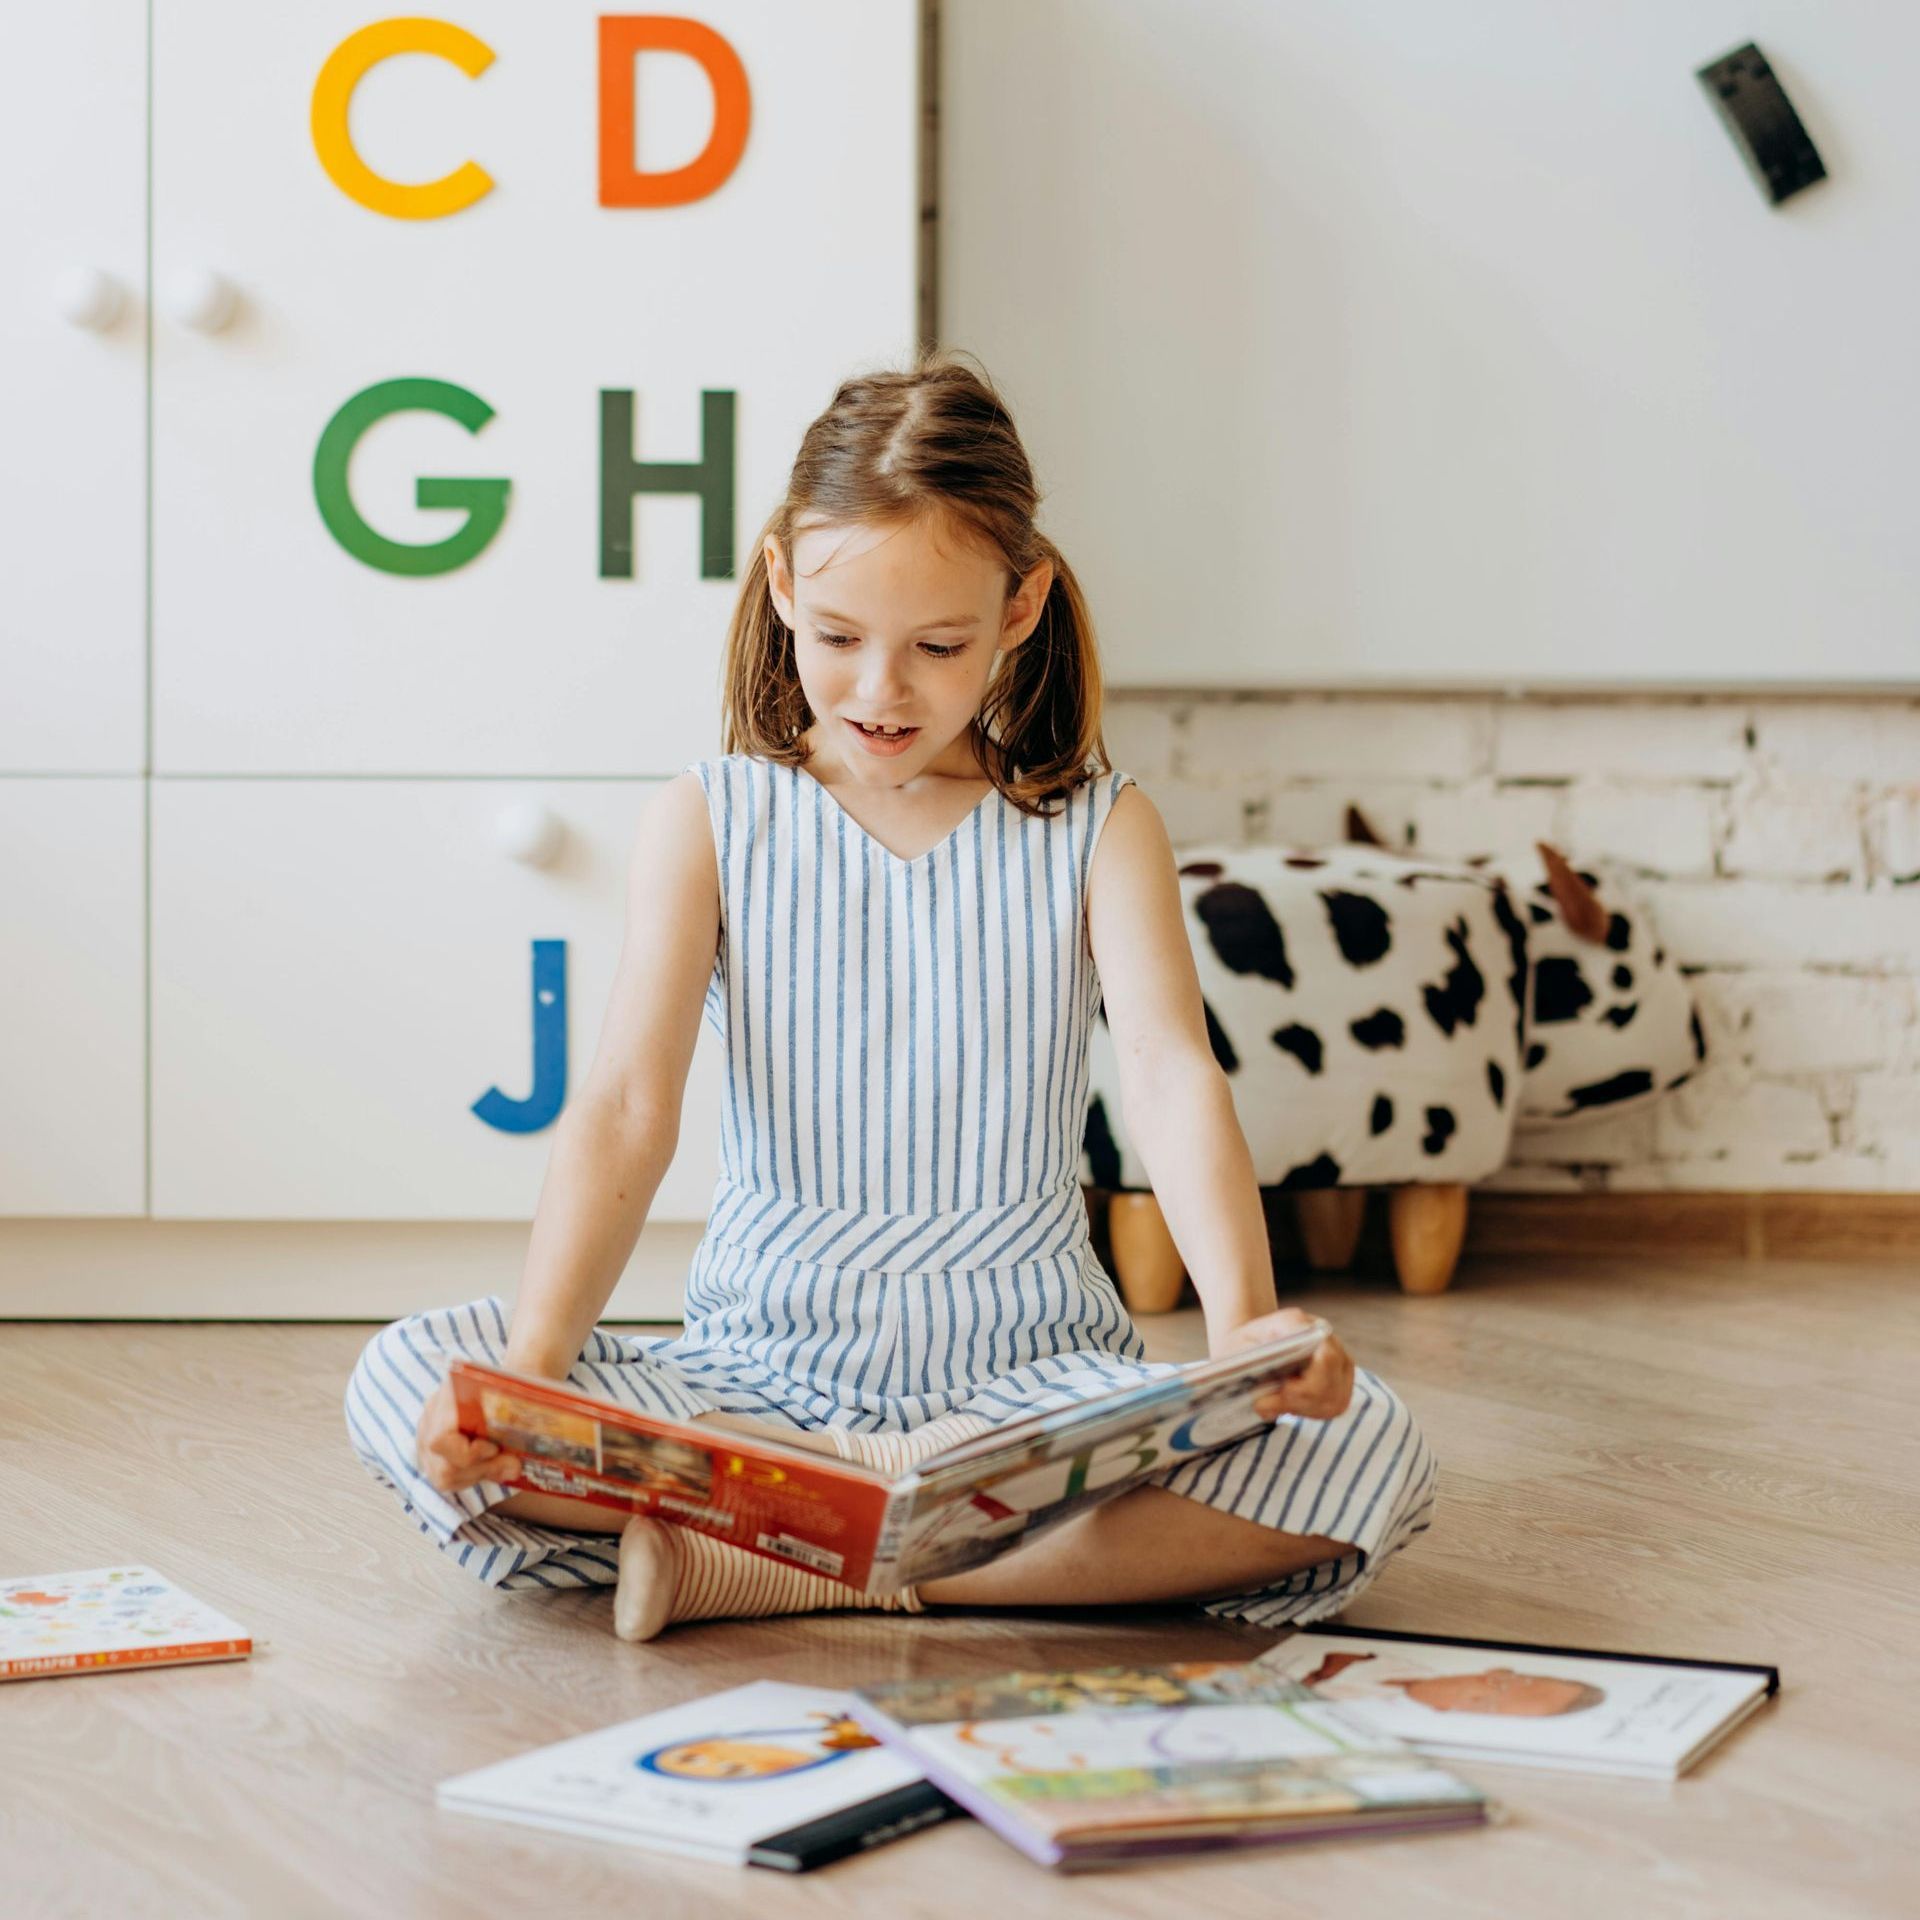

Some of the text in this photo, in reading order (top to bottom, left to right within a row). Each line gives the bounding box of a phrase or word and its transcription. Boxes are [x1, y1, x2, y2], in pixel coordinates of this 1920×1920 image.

[310, 15, 752, 221] C D
[314, 378, 735, 579] G H
[472, 940, 567, 1133] J
